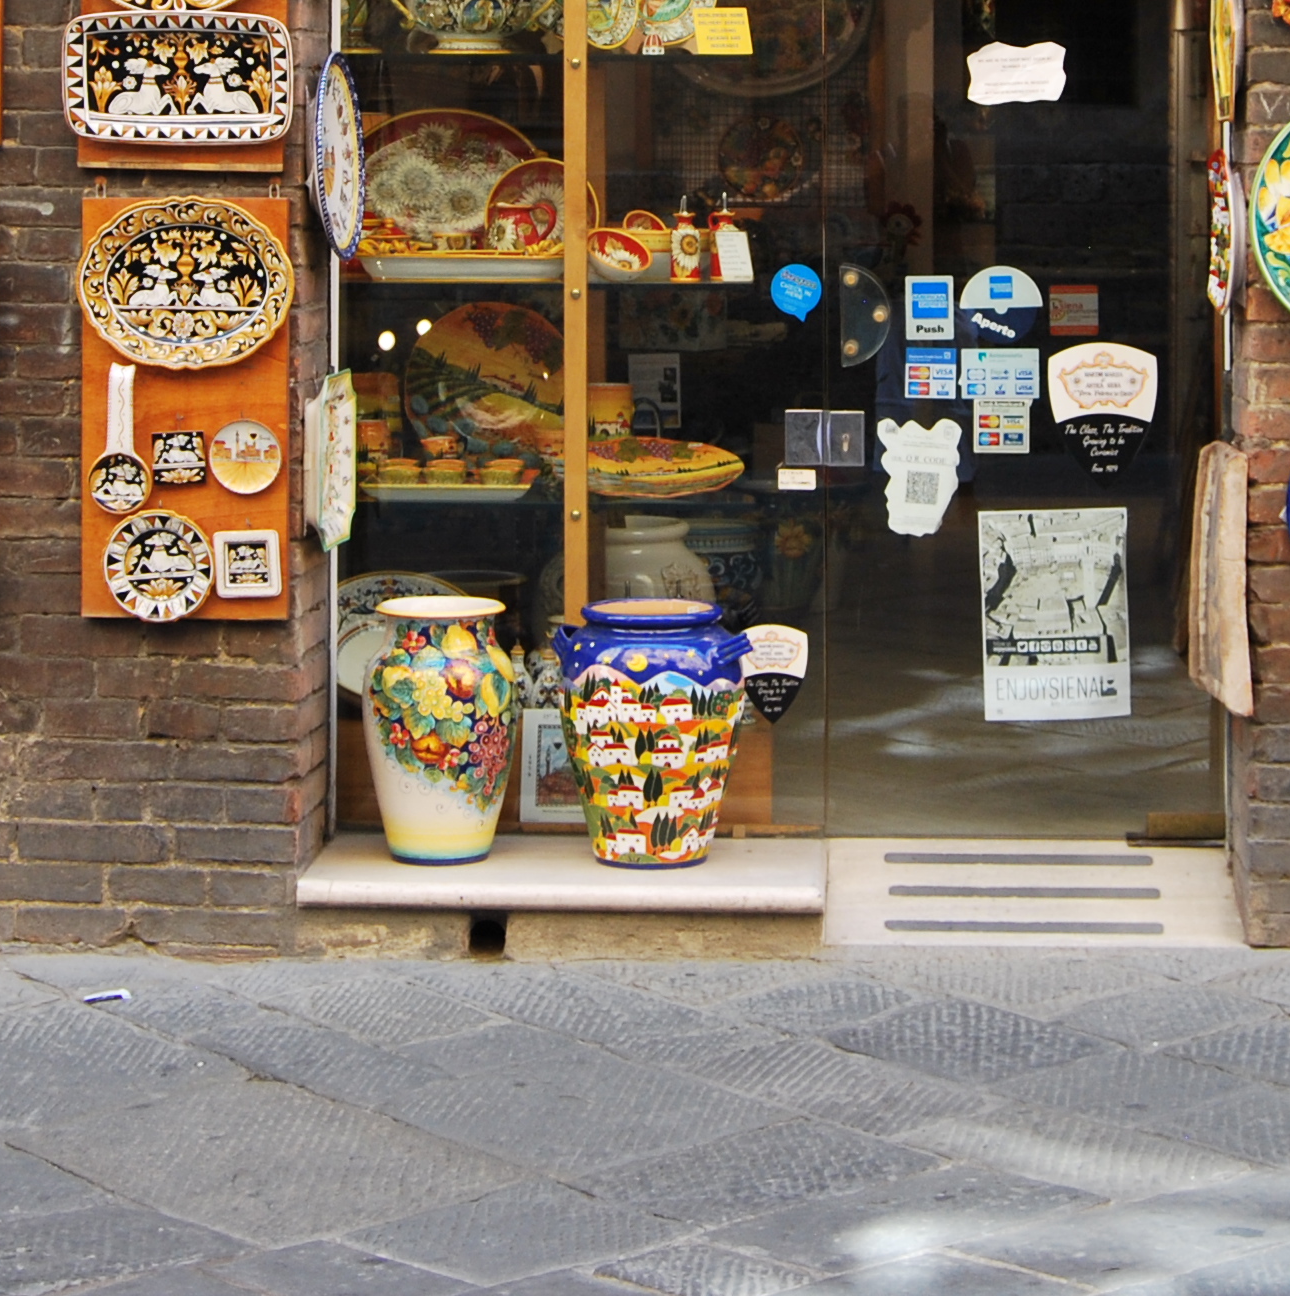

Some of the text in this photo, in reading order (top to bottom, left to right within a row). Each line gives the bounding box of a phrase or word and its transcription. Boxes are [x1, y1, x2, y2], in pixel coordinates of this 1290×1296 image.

[916, 324, 945, 334] Push
[971, 312, 1016, 339] Aperto
[1064, 423, 1077, 435] The
[1102, 423, 1115, 435] The
[923, 455, 948, 465] CODE
[996, 675, 1102, 701] ENJOYSIENA
